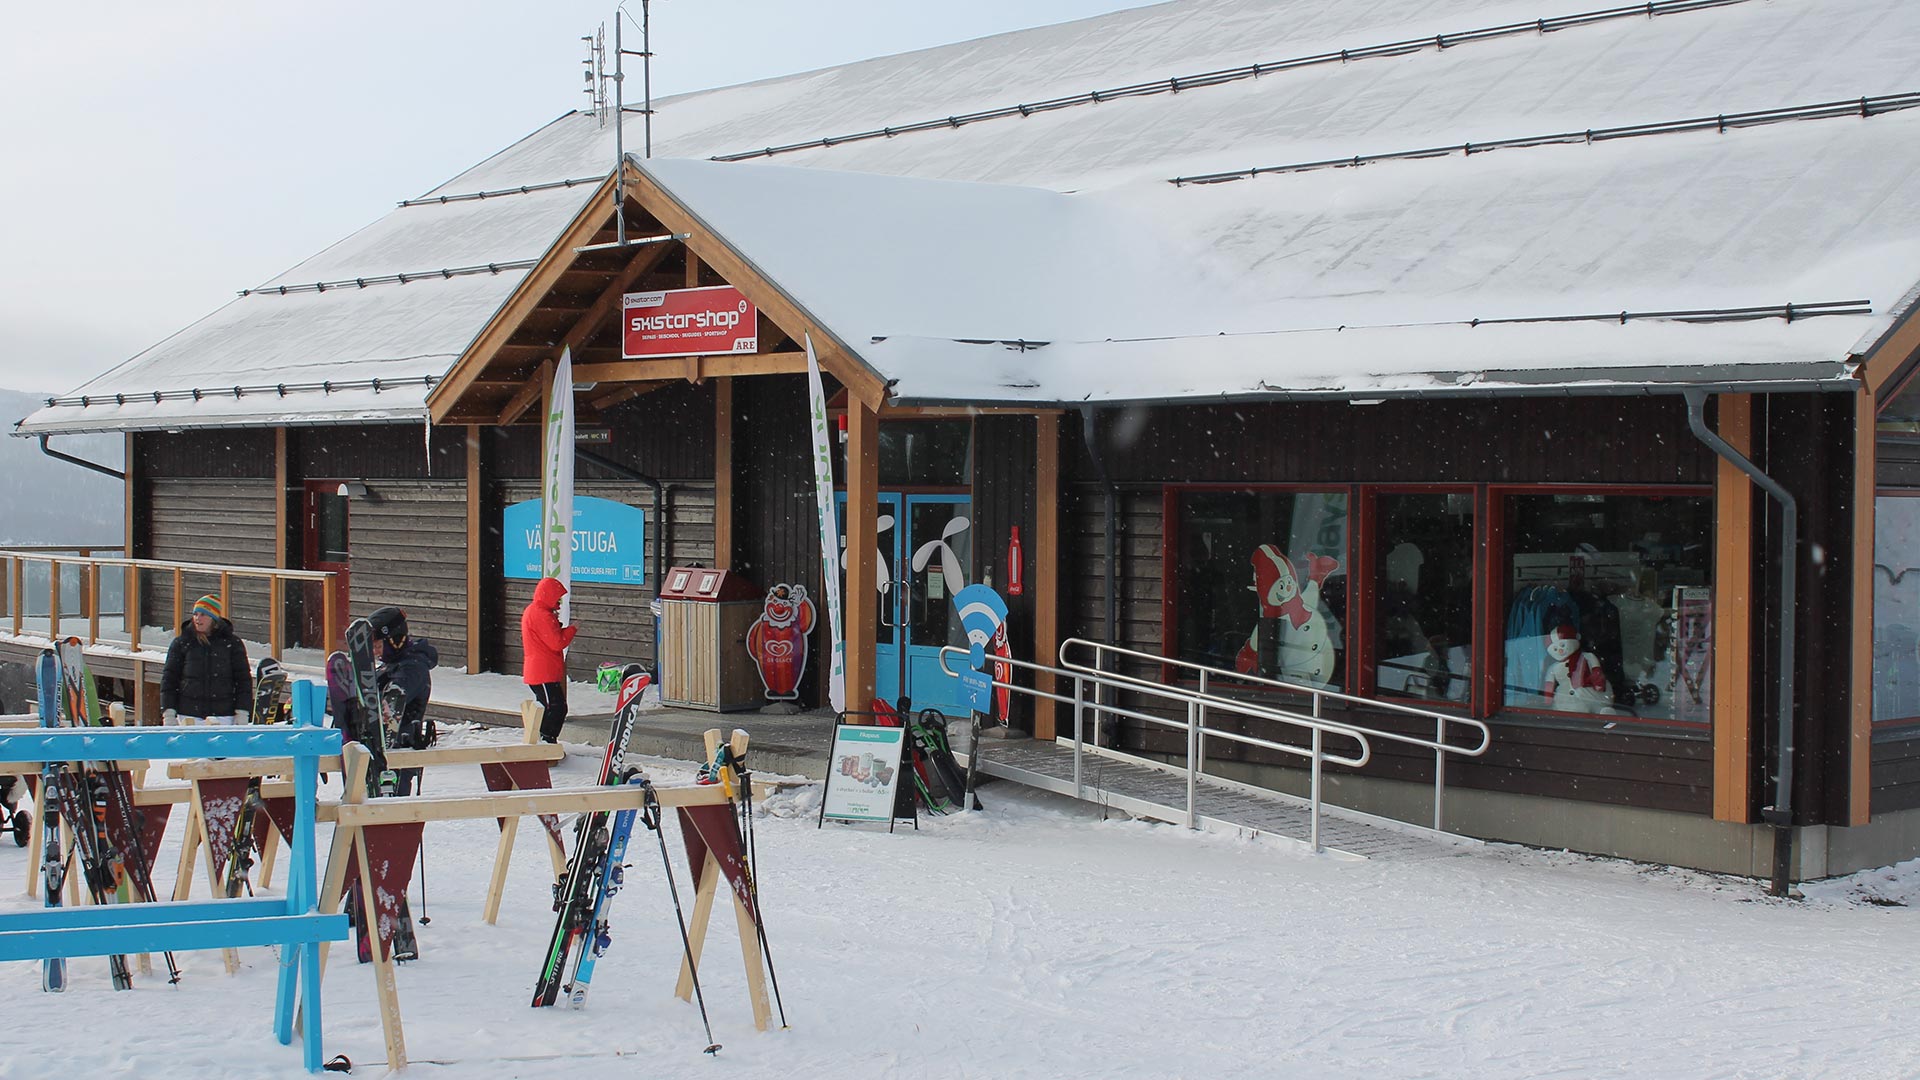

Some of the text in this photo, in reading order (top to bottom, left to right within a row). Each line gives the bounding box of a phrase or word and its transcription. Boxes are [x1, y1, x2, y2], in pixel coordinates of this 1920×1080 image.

[631, 309, 740, 332] skistarshop
[525, 524, 618, 553] VÄSTUGA
[612, 704, 639, 775] NORDICA
